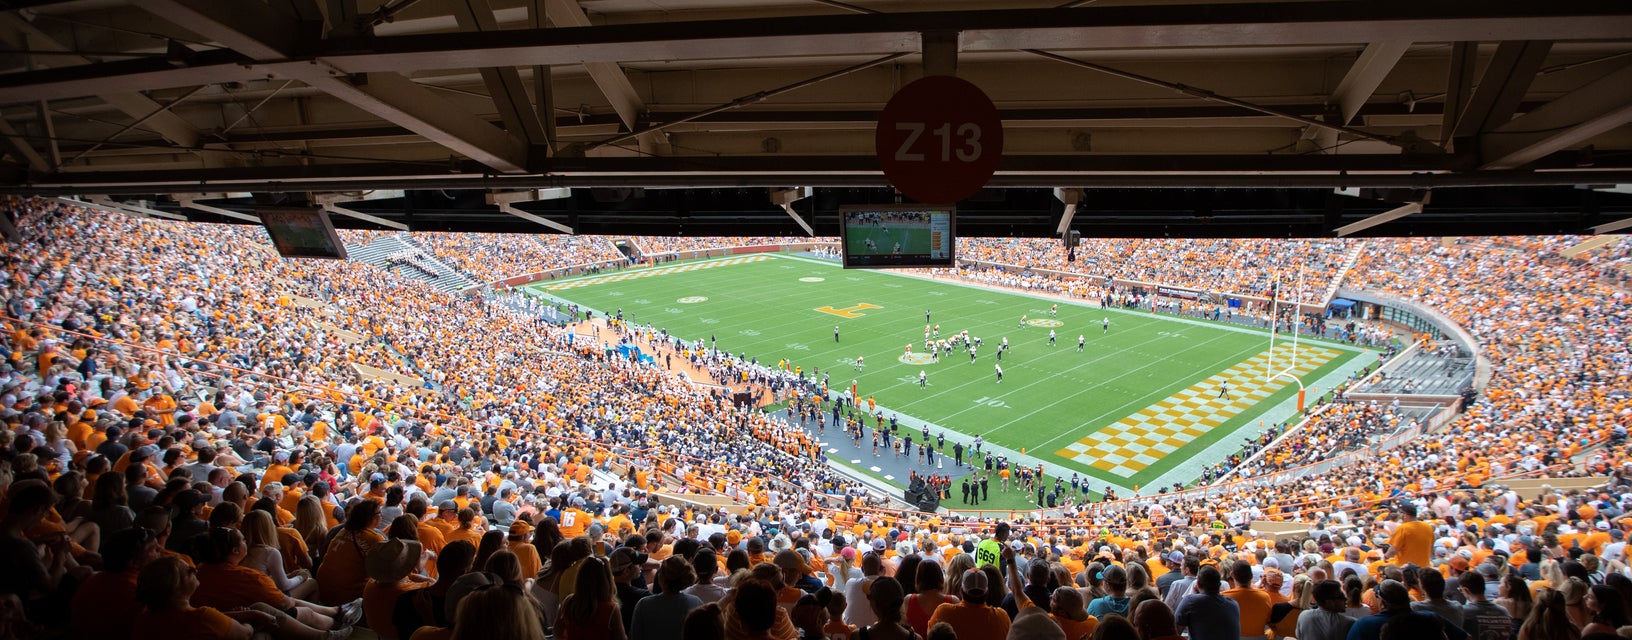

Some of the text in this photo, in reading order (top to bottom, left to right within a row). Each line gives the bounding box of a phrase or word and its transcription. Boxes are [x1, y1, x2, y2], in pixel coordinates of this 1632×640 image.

[895, 122, 982, 162] Z13
[973, 396, 1005, 408] 10
[563, 512, 576, 527] 16
[979, 548, 995, 564] 669
